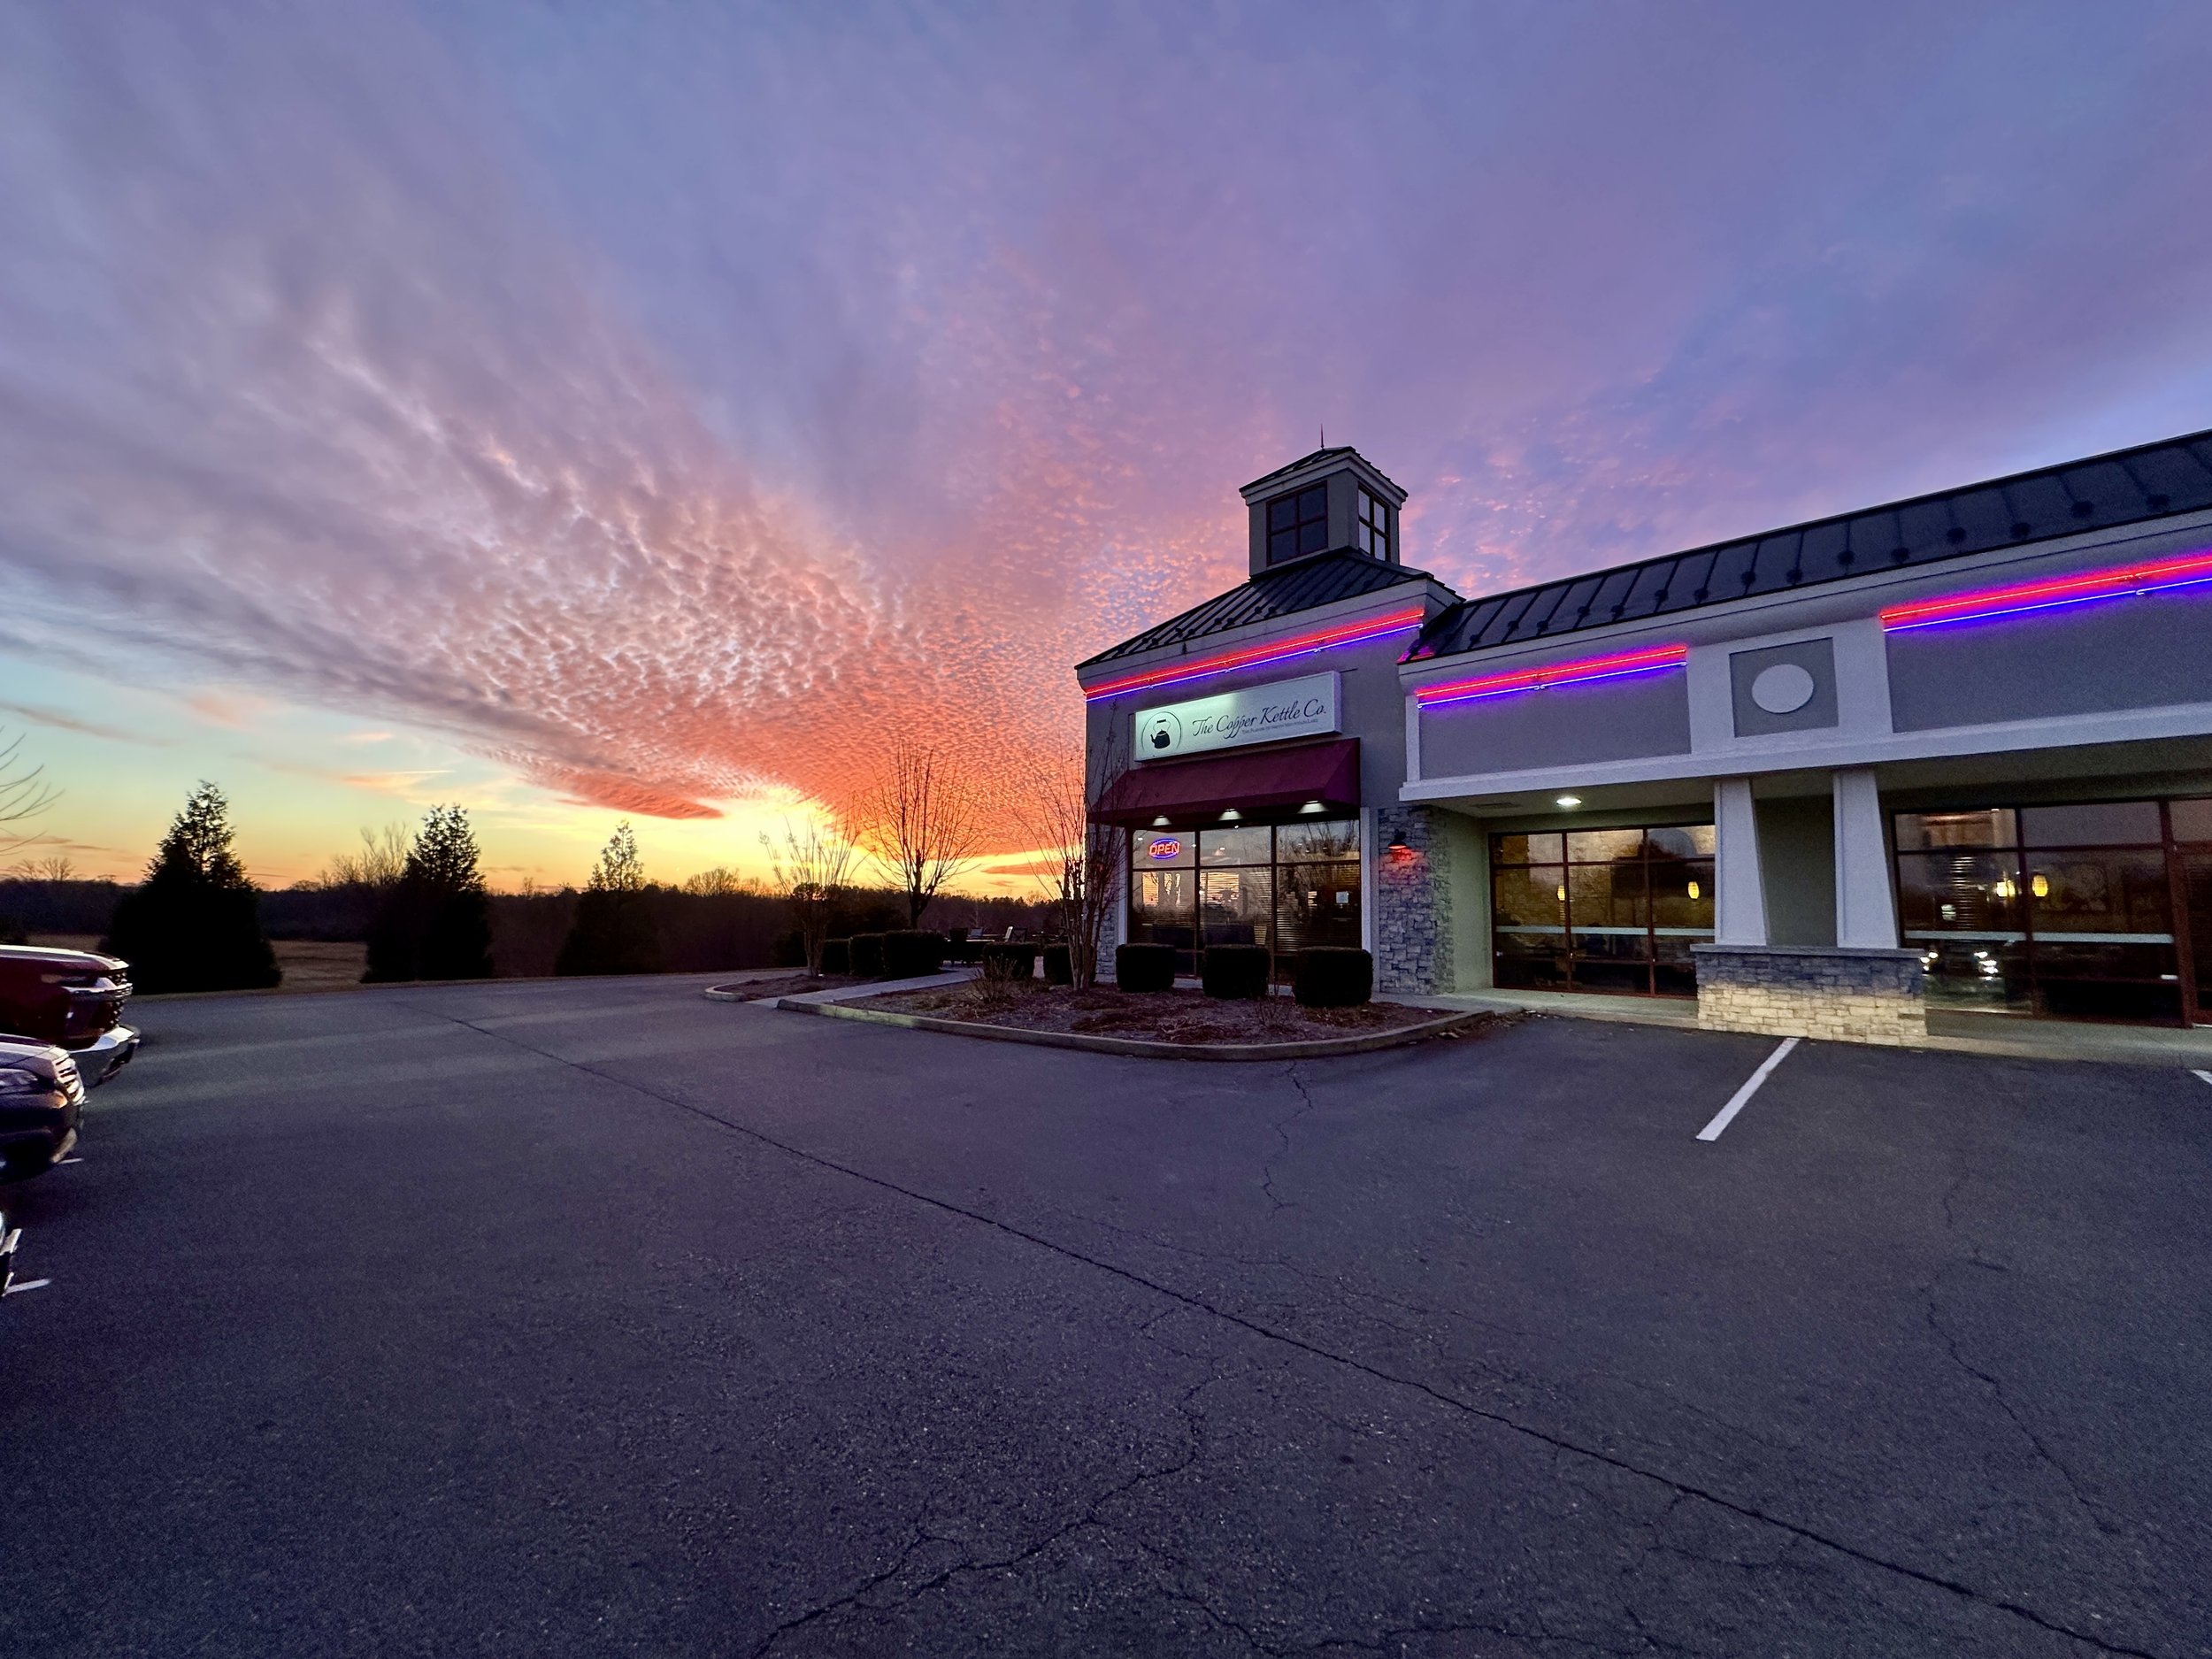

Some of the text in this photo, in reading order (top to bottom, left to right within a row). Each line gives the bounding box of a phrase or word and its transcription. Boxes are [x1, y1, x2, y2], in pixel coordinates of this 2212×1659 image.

[1192, 716, 1214, 736] The
[1216, 714, 1257, 739] Copper
[1260, 700, 1301, 724] Kettle
[1149, 842, 1180, 856] OPEN
